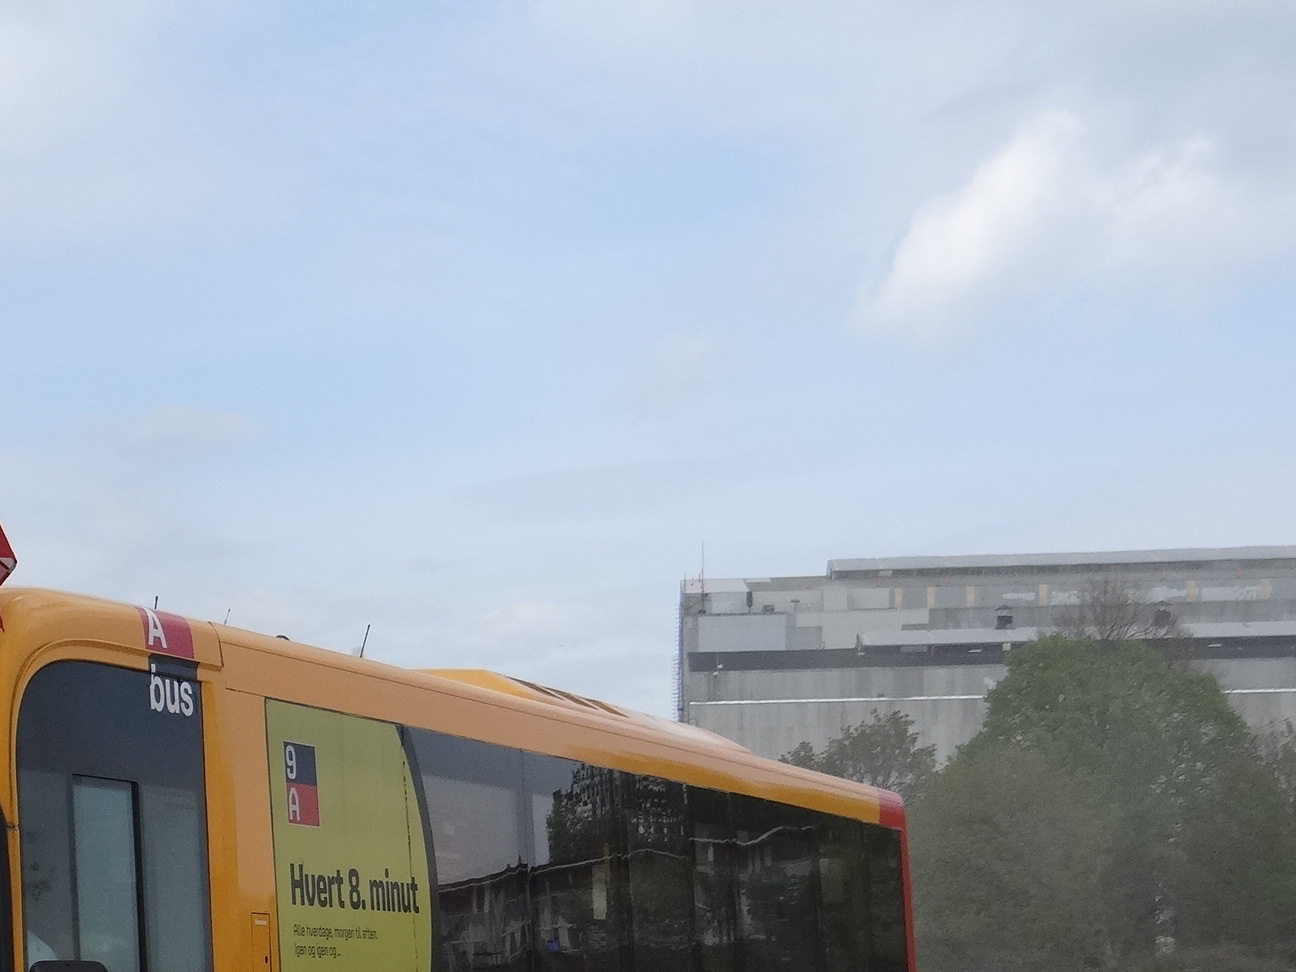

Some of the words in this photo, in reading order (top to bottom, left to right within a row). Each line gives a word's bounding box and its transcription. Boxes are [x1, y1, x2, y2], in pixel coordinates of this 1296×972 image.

[144, 607, 168, 649] A
[150, 663, 194, 717] bus
[286, 744, 297, 780] 9
[288, 786, 301, 822] A
[289, 863, 345, 909] Hvert
[348, 868, 366, 910] 8.
[369, 868, 420, 914] minut
